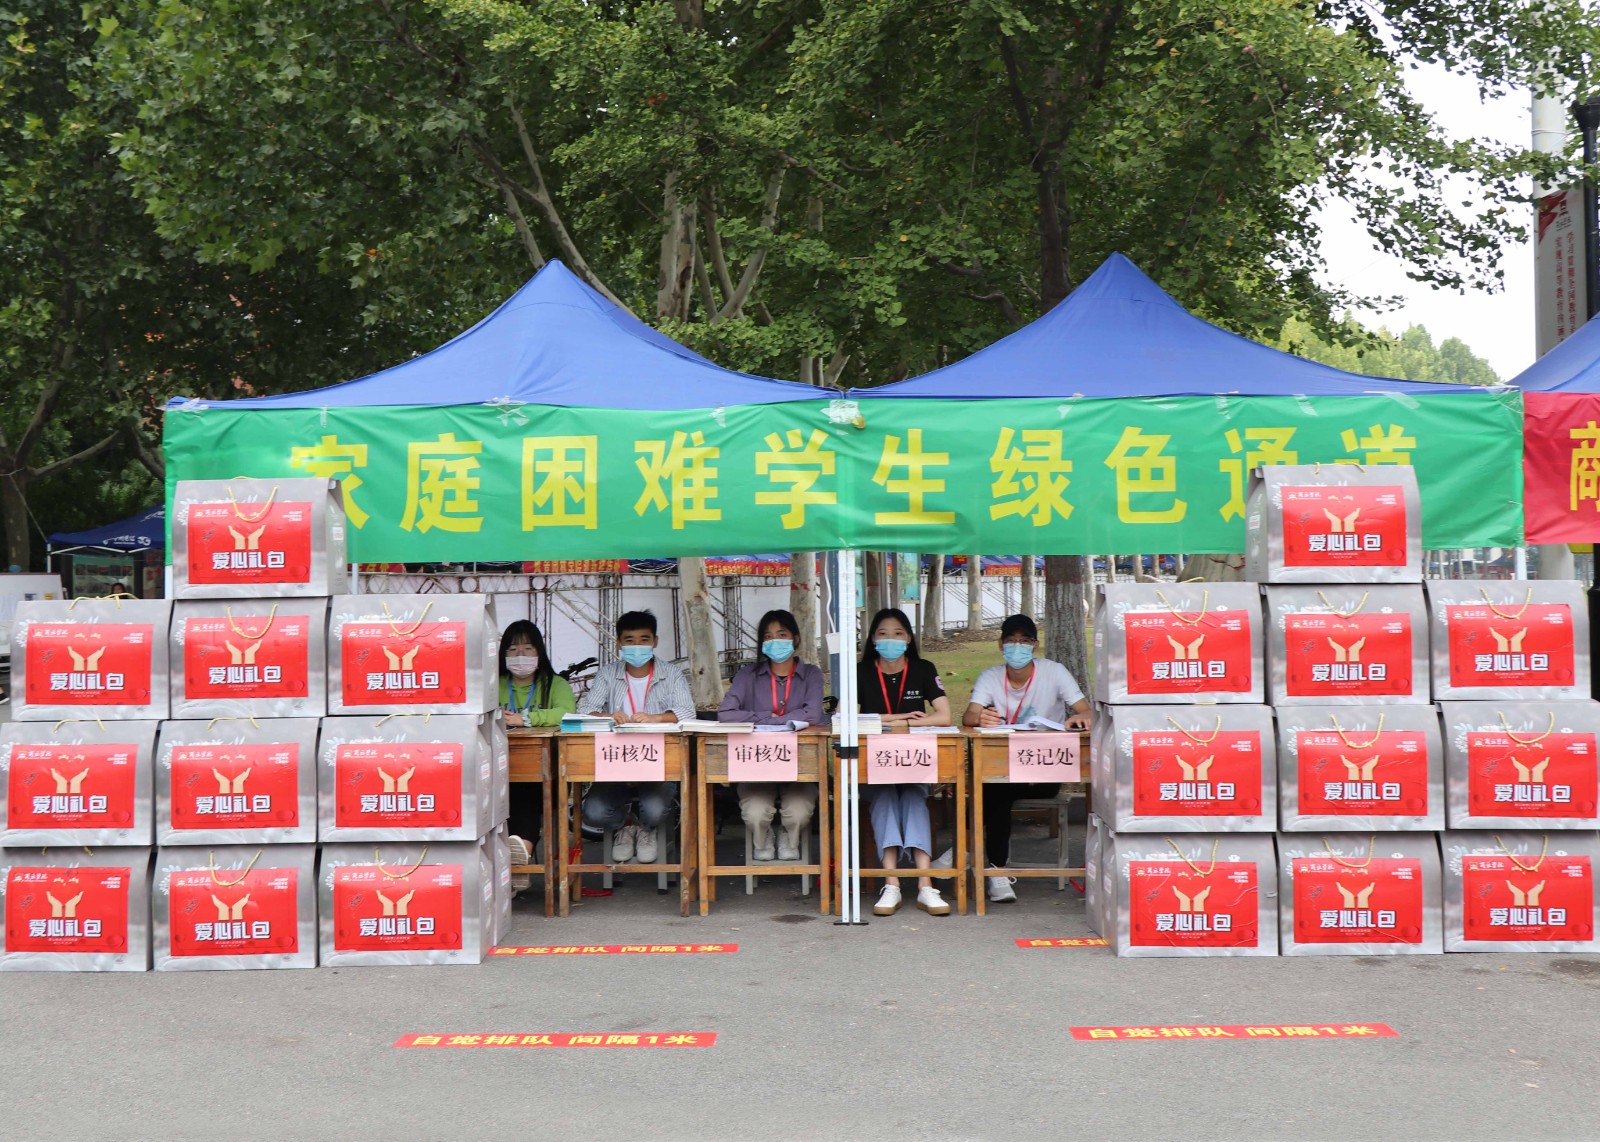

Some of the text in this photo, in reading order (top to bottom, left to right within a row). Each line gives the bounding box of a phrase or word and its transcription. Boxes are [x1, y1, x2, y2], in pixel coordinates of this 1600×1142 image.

[1307, 533, 1383, 553] 爱心礼包
[211, 550, 286, 570] 爱心礼包
[1151, 659, 1227, 680] 爱心礼包
[1311, 662, 1387, 682] 爱心礼包
[1473, 652, 1550, 673] 爱心礼包
[49, 672, 126, 691] 爱心礼包
[208, 664, 283, 685] 爱心礼包
[366, 670, 441, 691] 爱心礼包
[601, 743, 659, 763] 审核处
[734, 743, 792, 763] 审核处
[874, 748, 932, 767] 登记处
[1015, 747, 1074, 767] 登记处
[1158, 781, 1236, 802] 爱心礼包
[1323, 781, 1402, 801] 爱心礼包
[1493, 783, 1572, 803] 爱心礼包
[30, 794, 109, 814] 爱心礼包
[195, 793, 272, 815] 爱心礼包
[359, 793, 437, 813] 爱心礼包
[1155, 912, 1233, 933] 爱心礼包
[1319, 909, 1397, 929] 爱心礼包
[1489, 906, 1567, 926] 爱心礼包
[27, 918, 103, 938] 爱心礼包
[194, 919, 272, 942] 爱心礼包
[358, 916, 436, 937] 爱心礼包
[495, 945, 724, 955] 自觉排队 间隔1米
[411, 1034, 699, 1046] 自觉排队 间隔1米
[1088, 1025, 1379, 1039] 自觉排队 间隔1米
